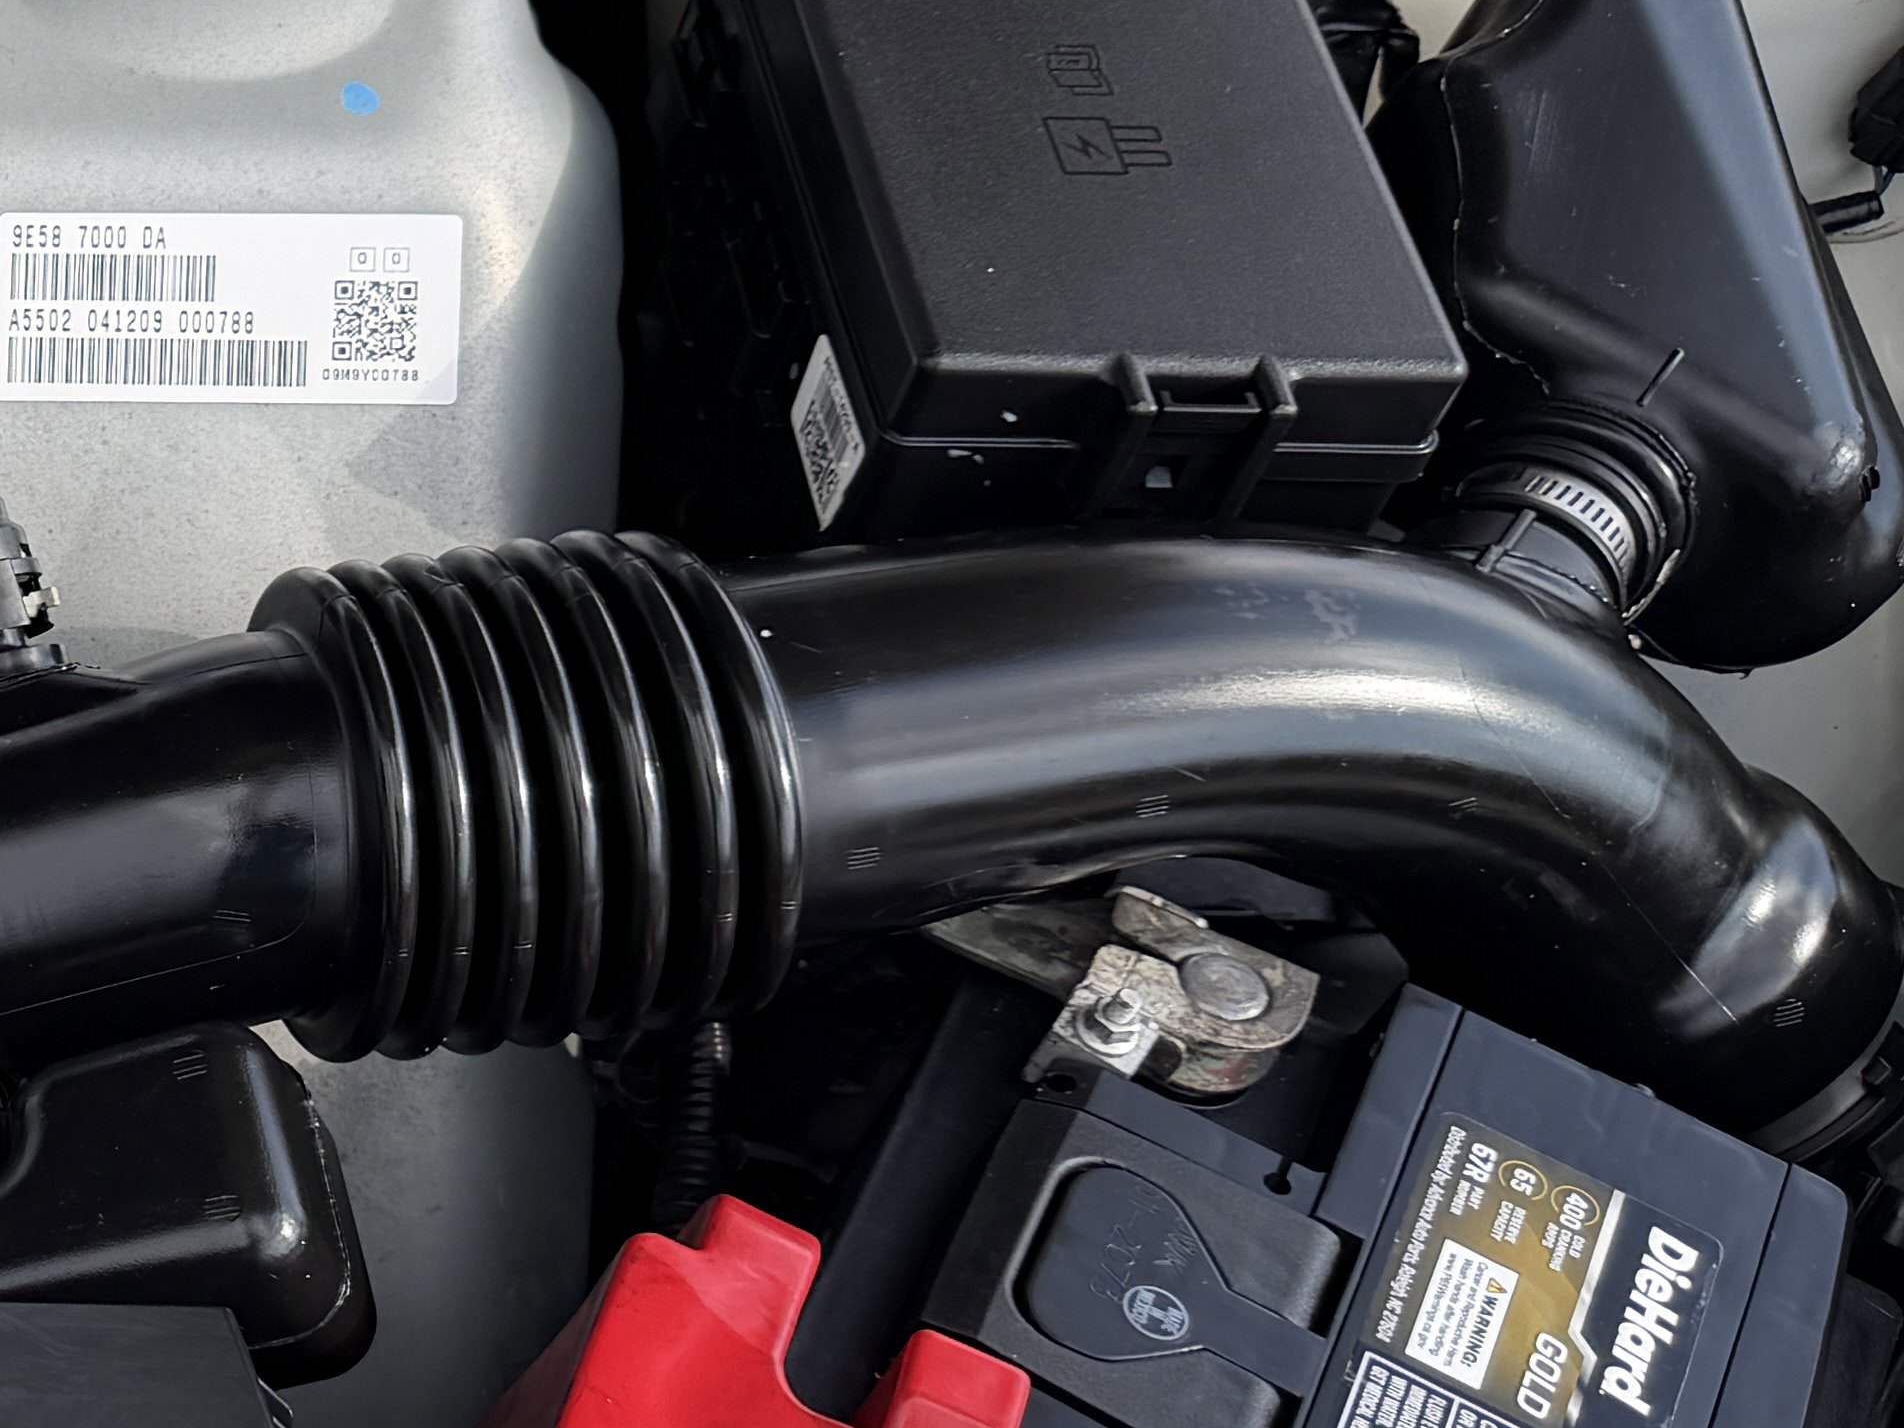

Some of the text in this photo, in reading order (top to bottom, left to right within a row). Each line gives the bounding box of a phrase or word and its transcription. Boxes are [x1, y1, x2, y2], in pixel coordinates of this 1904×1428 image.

[78, 225, 127, 249] 7000
[142, 226, 167, 249] DA
[8, 308, 256, 334] A5502 041209 000788
[1508, 1165, 1536, 1196] 65
[1557, 1190, 1589, 1232] 400
[1459, 1292, 1498, 1370] WARNING:
[1597, 1223, 1702, 1419] DieHard
[1513, 1329, 1571, 1421] GOLD
